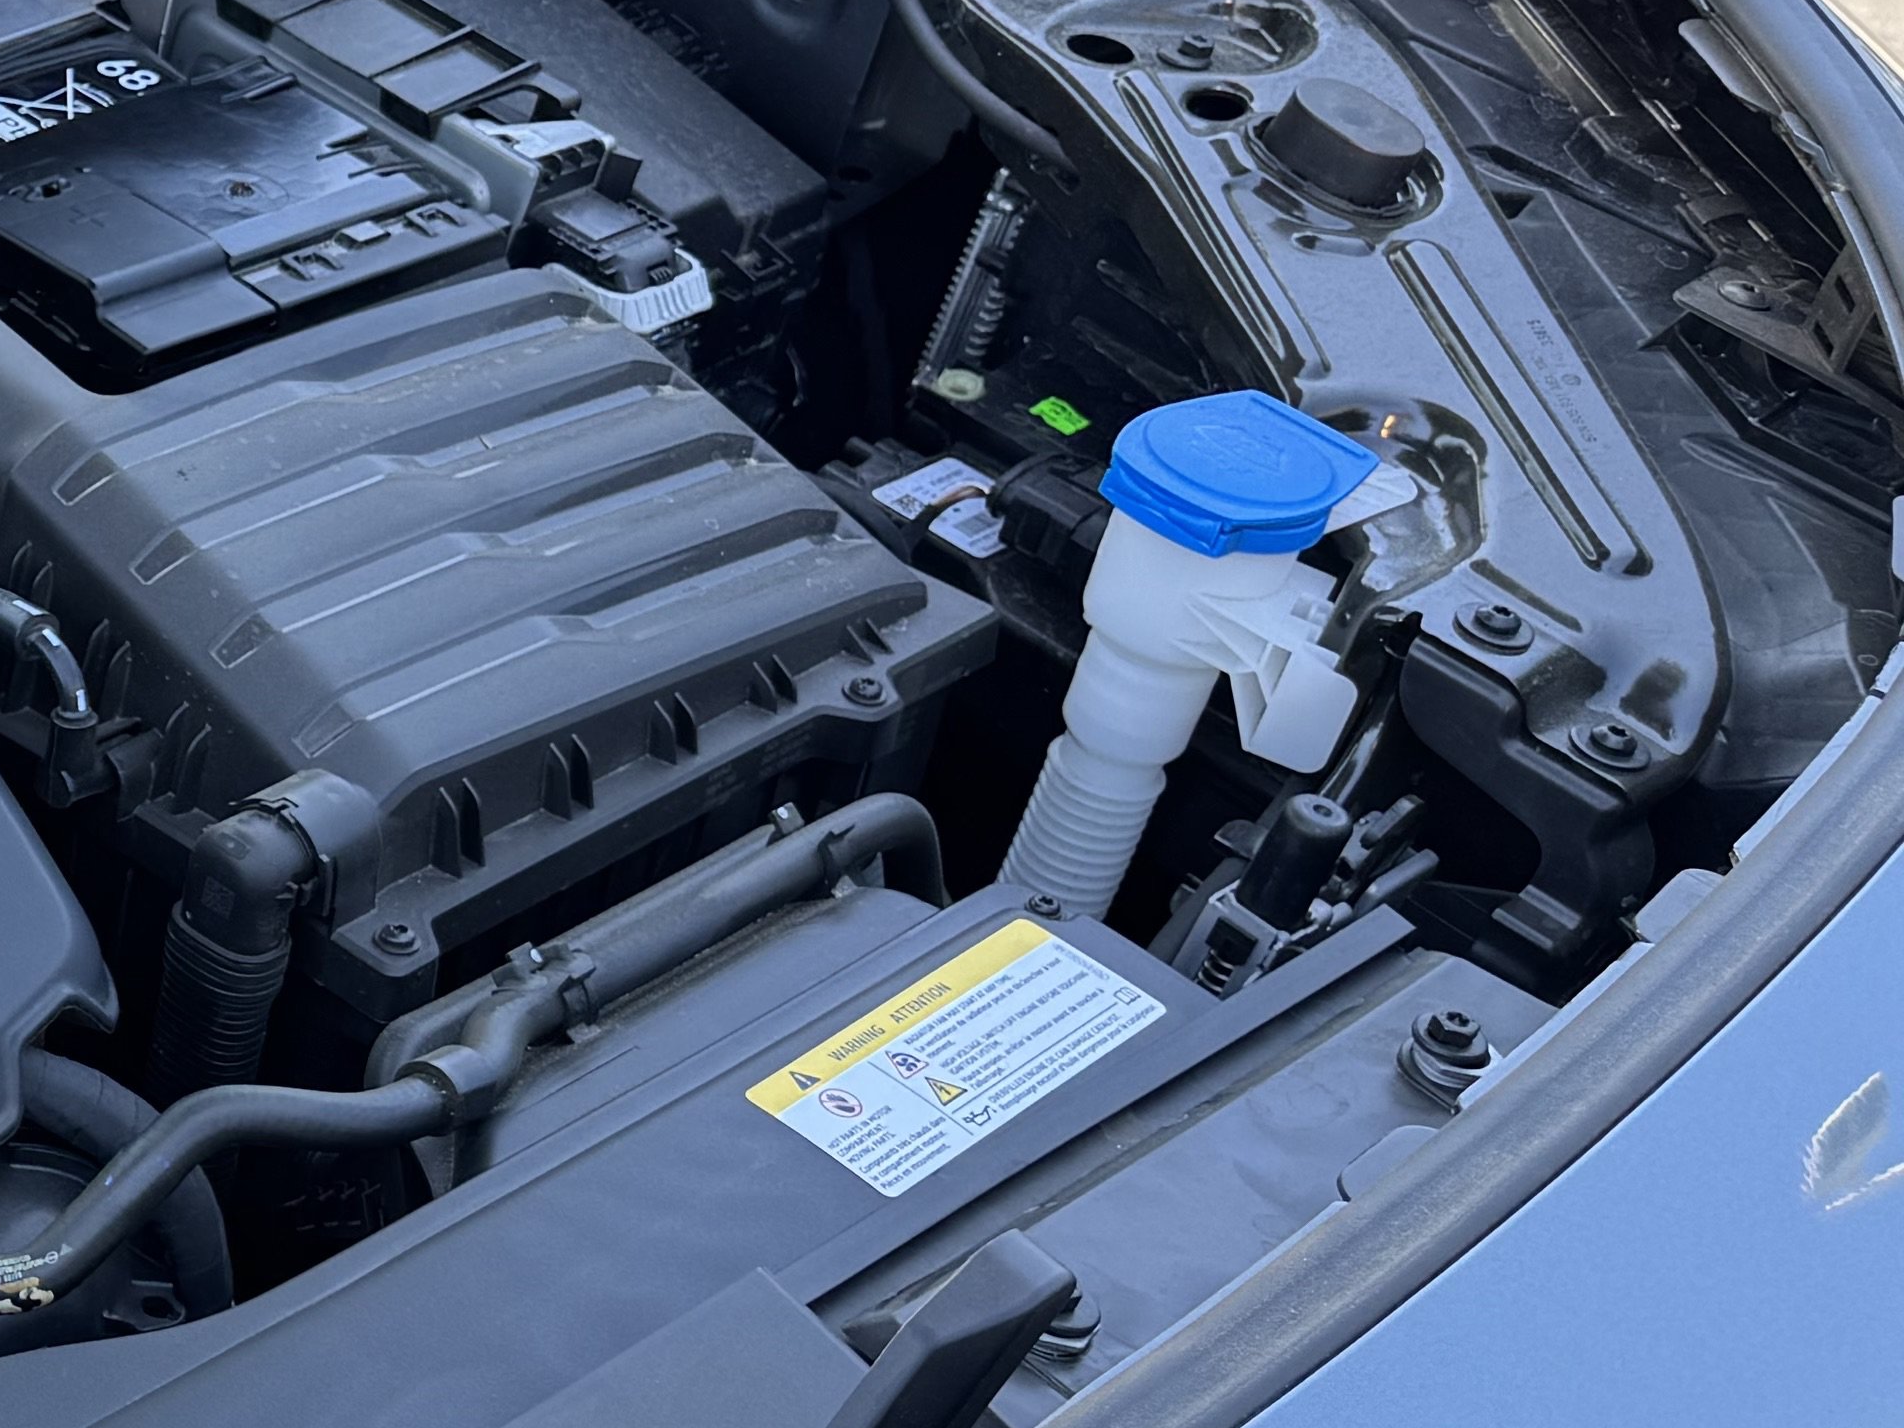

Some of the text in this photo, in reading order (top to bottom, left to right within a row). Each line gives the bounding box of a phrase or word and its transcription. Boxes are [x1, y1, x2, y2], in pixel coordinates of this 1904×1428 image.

[96, 60, 160, 90] 68
[828, 983, 951, 1061] WARNING ATTENTION
